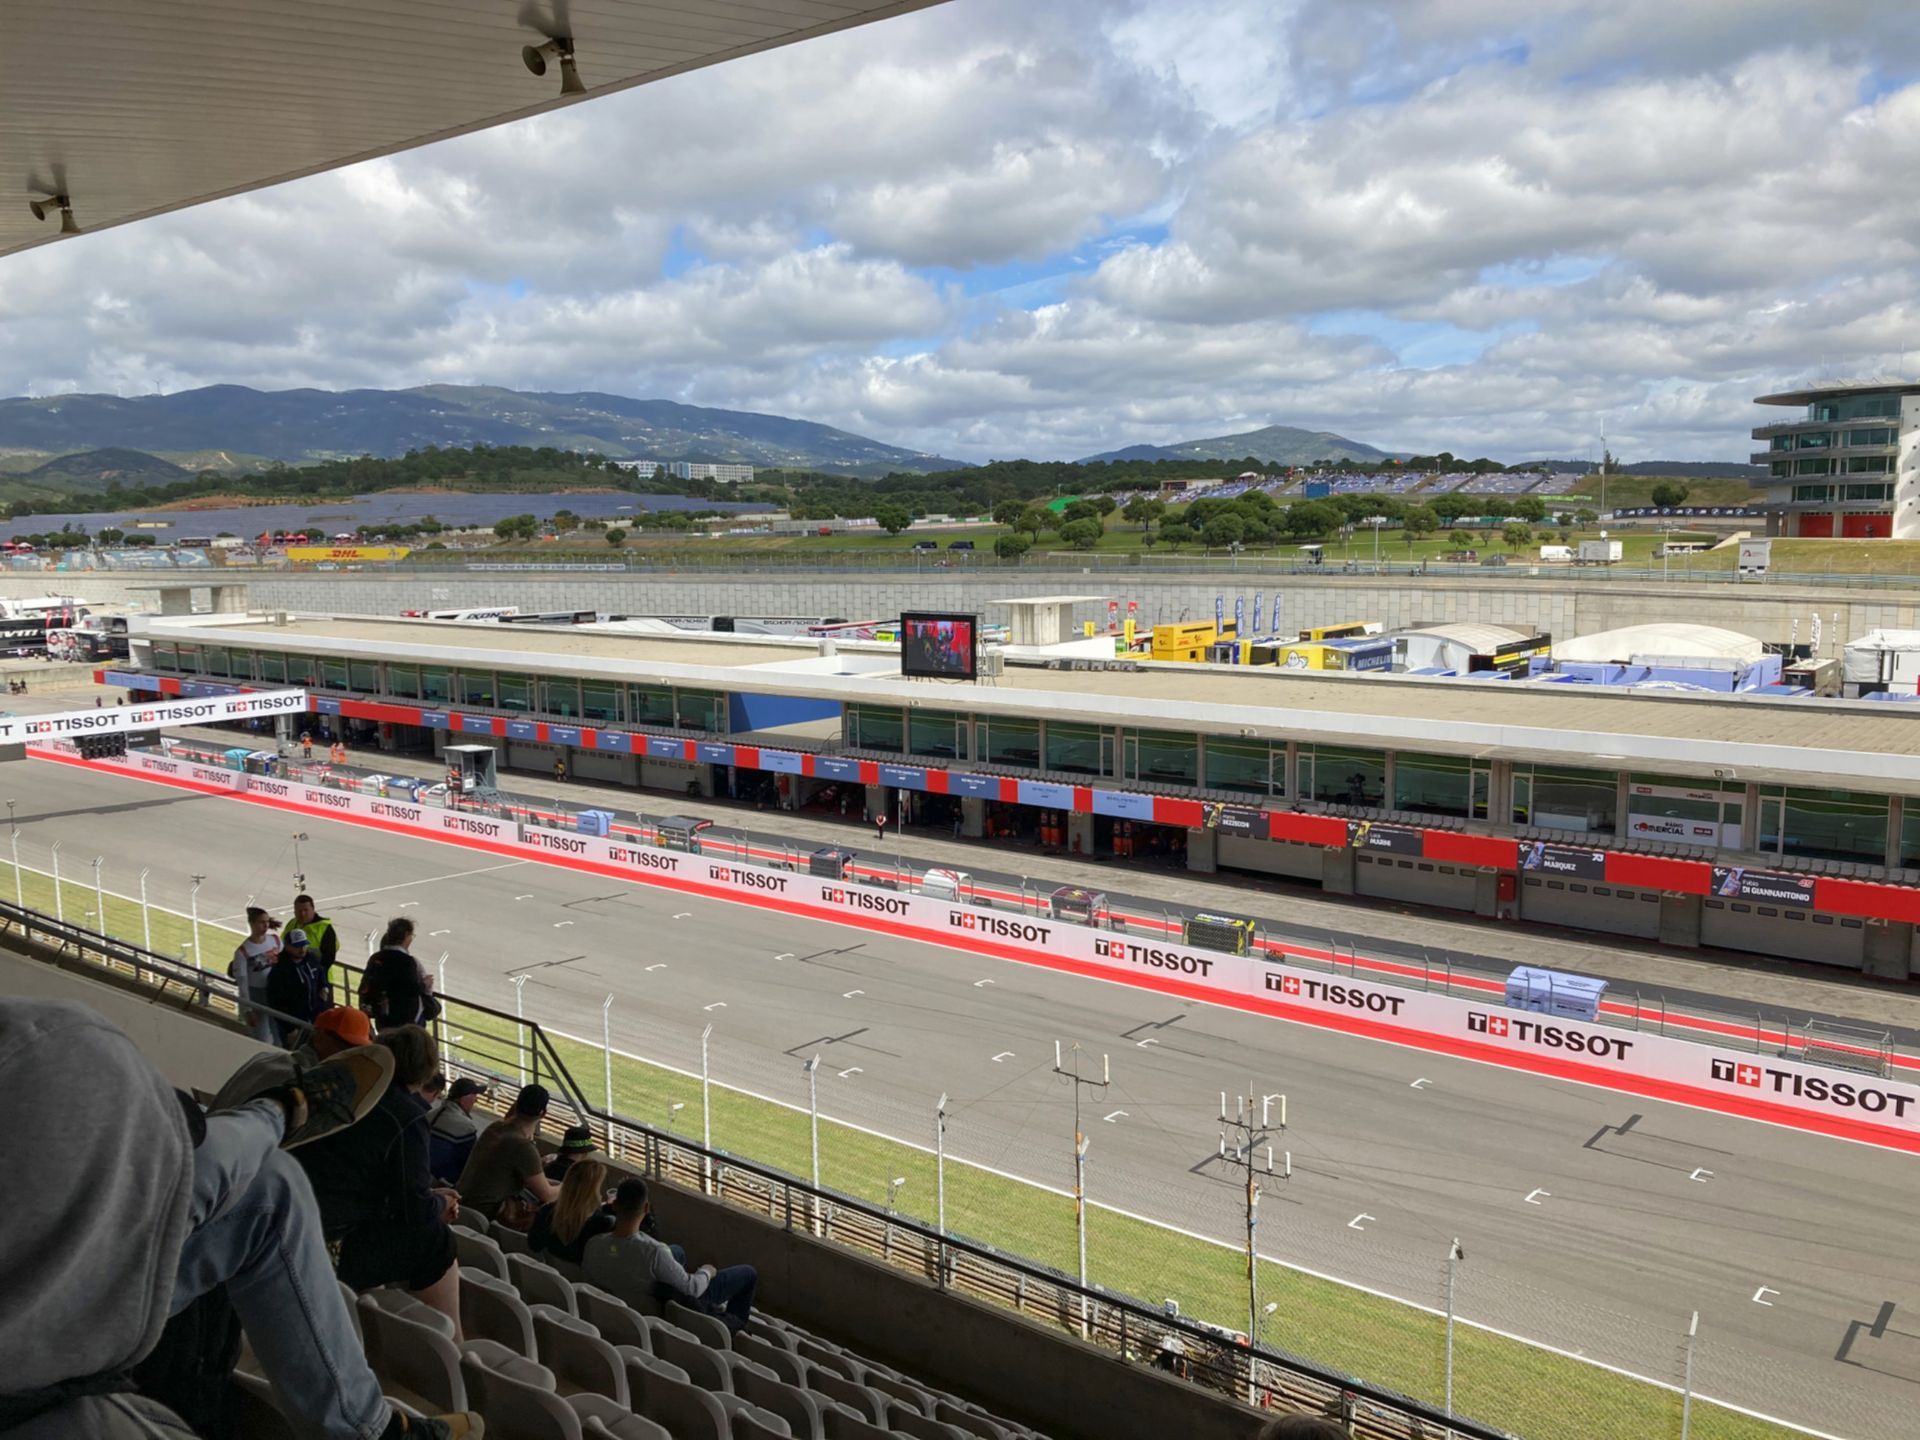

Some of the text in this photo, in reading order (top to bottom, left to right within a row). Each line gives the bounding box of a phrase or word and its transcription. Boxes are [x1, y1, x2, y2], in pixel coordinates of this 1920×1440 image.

[331, 549, 359, 558] DHL
[1356, 653, 1393, 669] MICHELIN
[247, 695, 304, 711] TISSOT
[159, 704, 216, 721] TISSOT
[54, 713, 119, 731] TISSOT
[152, 760, 179, 773] TISSOT
[203, 769, 231, 784] TISSOT
[260, 781, 289, 797] TISSOT
[317, 794, 352, 809] TISSOT
[384, 807, 422, 822] TISSOT
[460, 818, 500, 837] TISSOT
[541, 834, 587, 854] TISSOT
[628, 850, 679, 872] TISSOT
[1543, 860, 1577, 872] MARQUEZ
[730, 870, 788, 892] TISSOT
[1742, 886, 1810, 902] DI GIANNANTONIO
[846, 890, 910, 916] TISSOT
[977, 916, 1051, 944] TISSOT
[1127, 945, 1213, 977] TISSOT
[1303, 980, 1405, 1016] TISSOT
[1512, 1019, 1633, 1061] TISSOT
[1766, 1068, 1915, 1117] TISSOT
